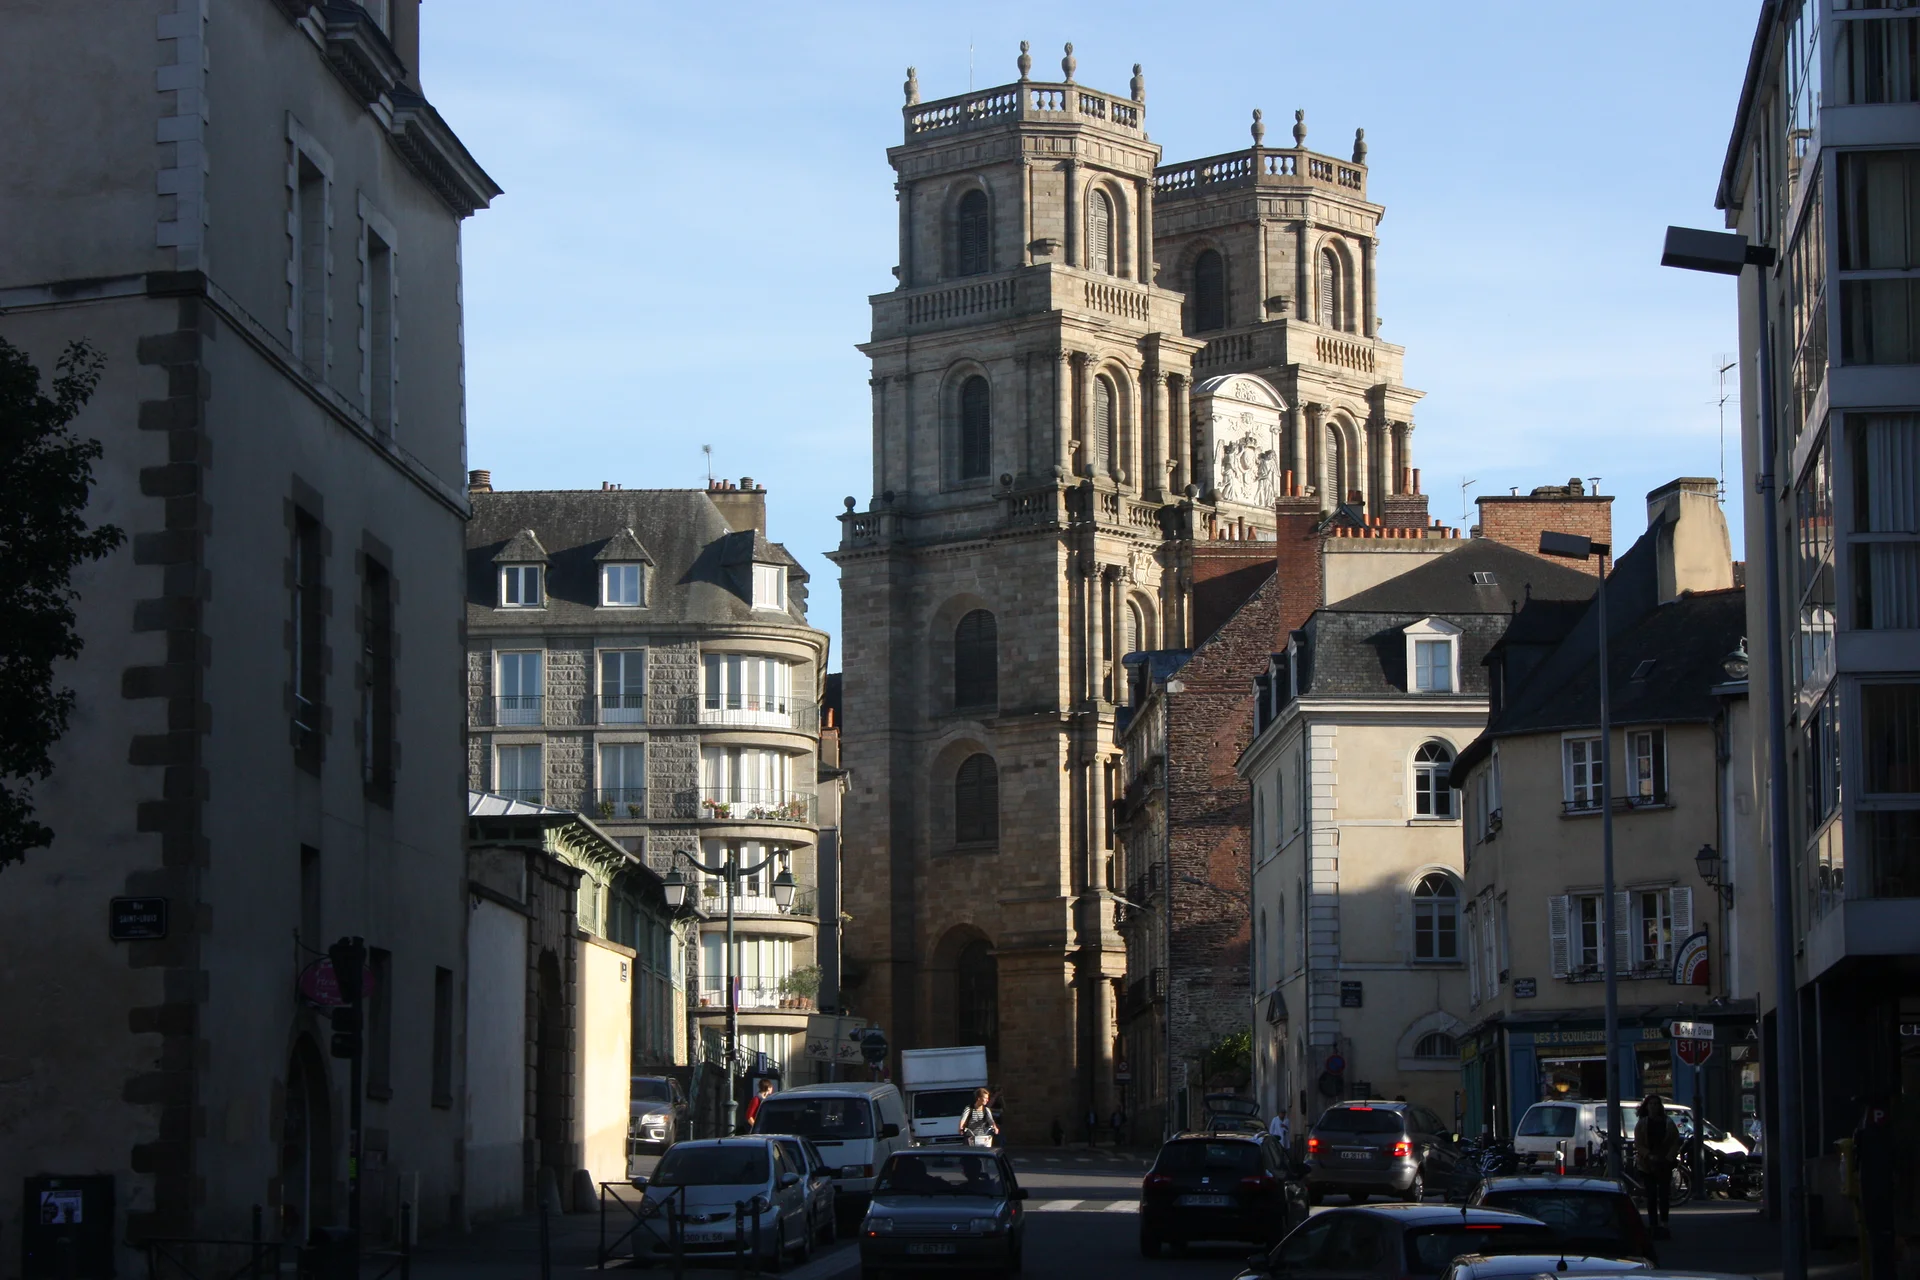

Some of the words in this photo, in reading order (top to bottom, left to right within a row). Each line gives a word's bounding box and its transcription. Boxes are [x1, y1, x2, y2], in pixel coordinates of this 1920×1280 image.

[1534, 1032, 1550, 1043] LES
[1553, 1031, 1559, 1043] 3
[1680, 1041, 1708, 1052] STP
